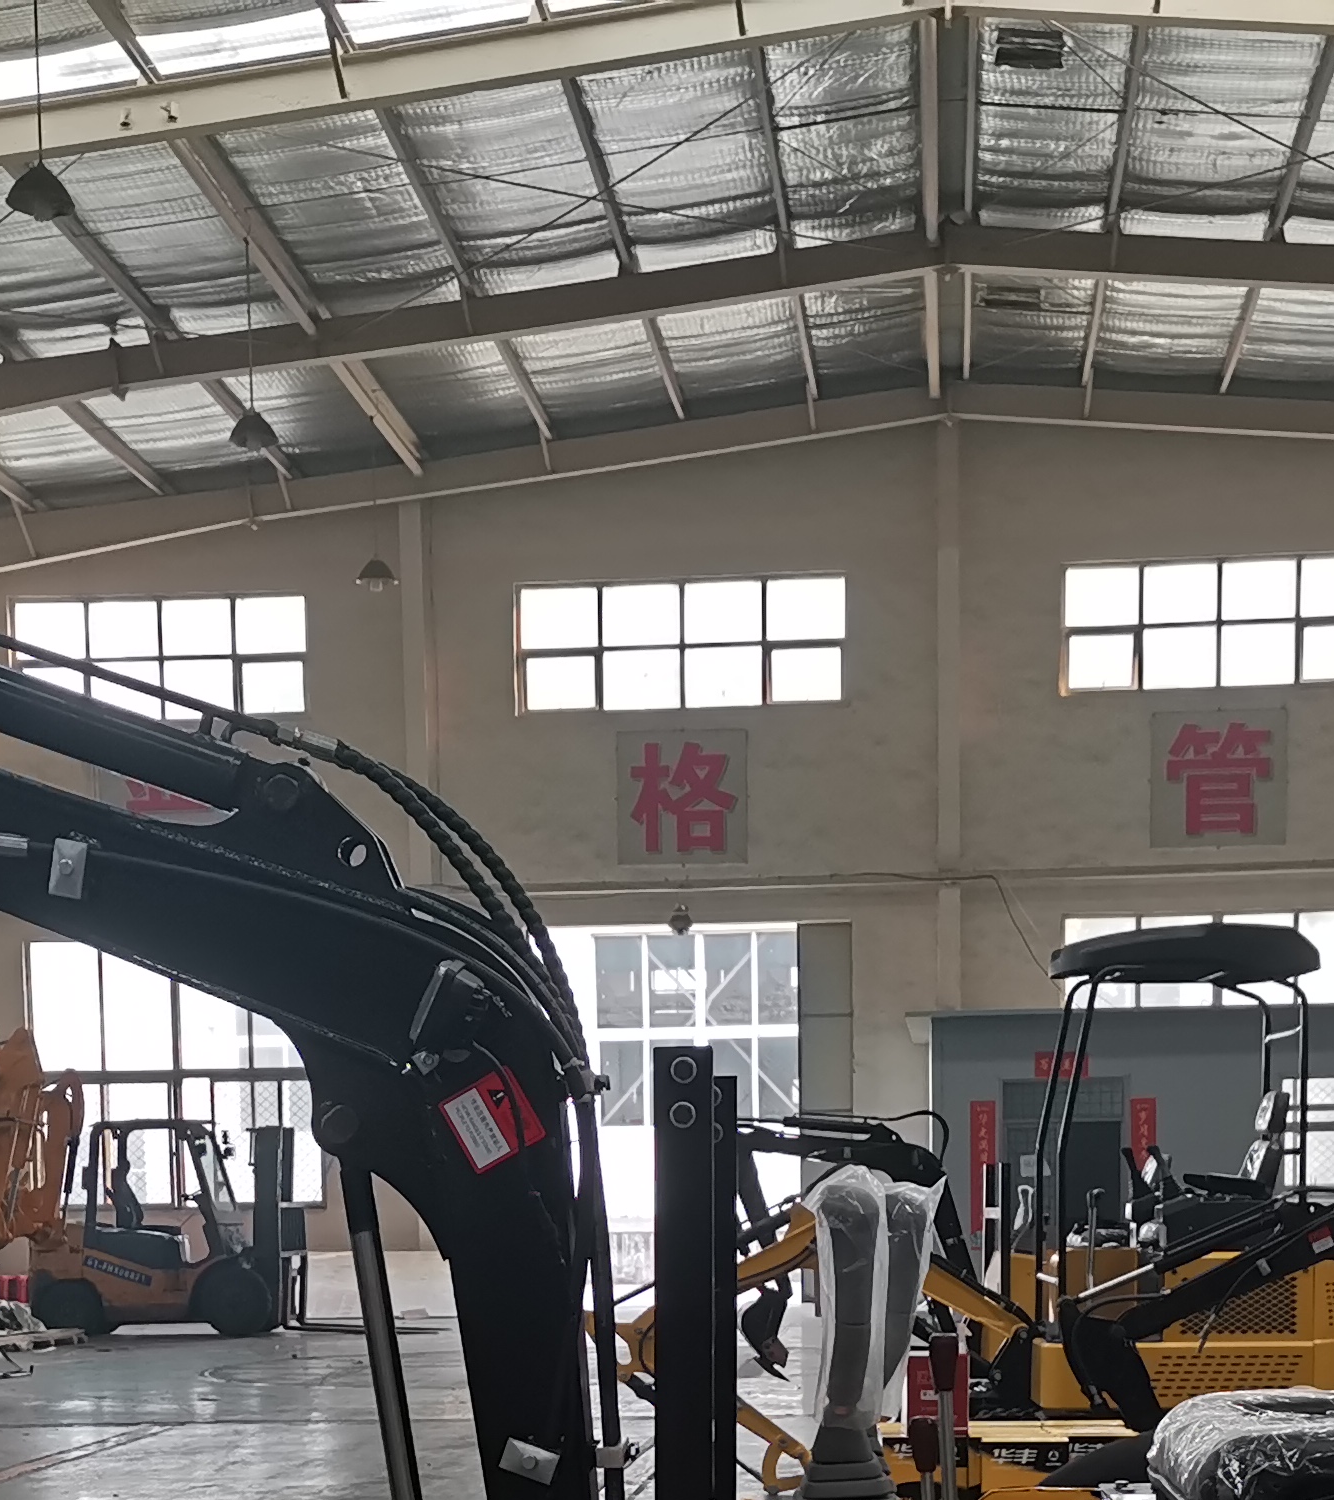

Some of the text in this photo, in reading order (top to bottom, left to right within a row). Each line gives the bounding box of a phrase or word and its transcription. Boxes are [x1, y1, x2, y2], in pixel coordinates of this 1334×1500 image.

[630, 742, 738, 854] 格
[1167, 722, 1272, 835] 管
[990, 1448, 1038, 1465] 华丰
